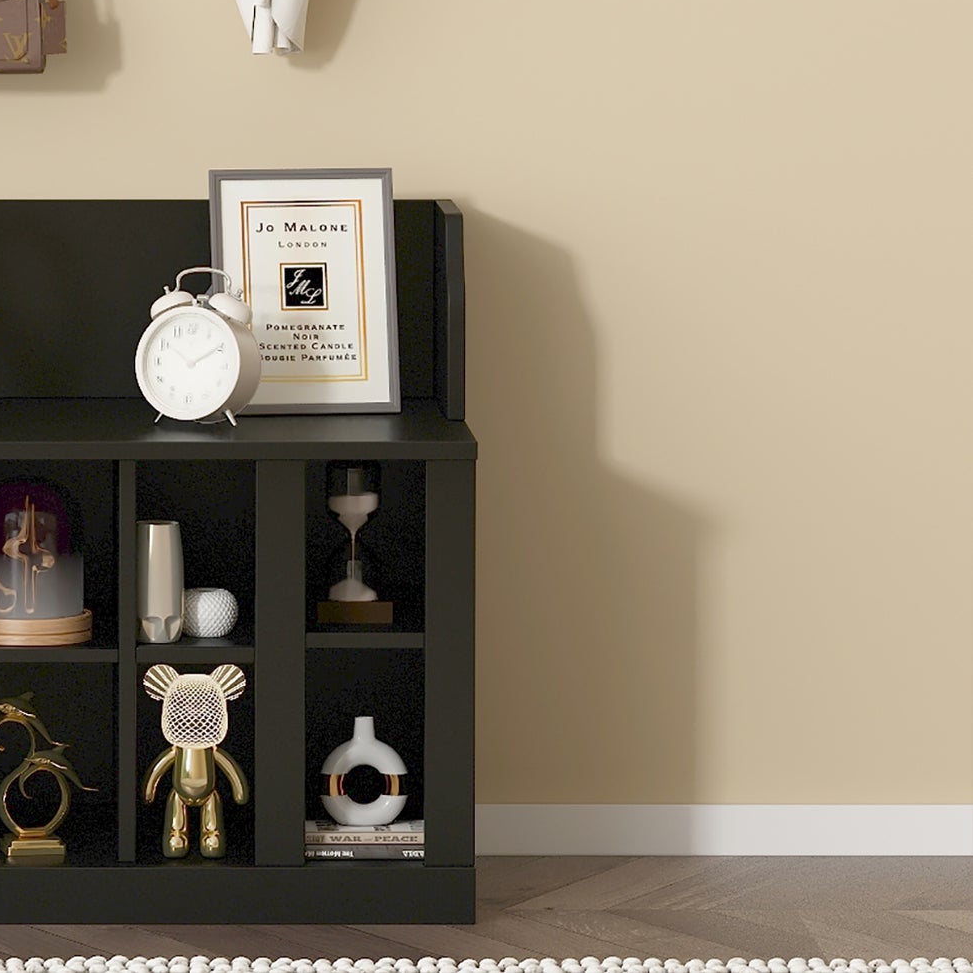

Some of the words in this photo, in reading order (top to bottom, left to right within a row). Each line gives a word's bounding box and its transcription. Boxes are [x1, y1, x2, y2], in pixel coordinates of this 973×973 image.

[255, 222, 275, 233] JO
[283, 222, 348, 233] MALONE
[278, 240, 328, 248] LONDON
[266, 323, 346, 331] POMEGRANATE
[292, 333, 320, 341] NOIR
[259, 342, 307, 351] SCENTED
[311, 342, 354, 350] CANDLE
[329, 835, 362, 843] WAR
[374, 835, 419, 843] PEACE
